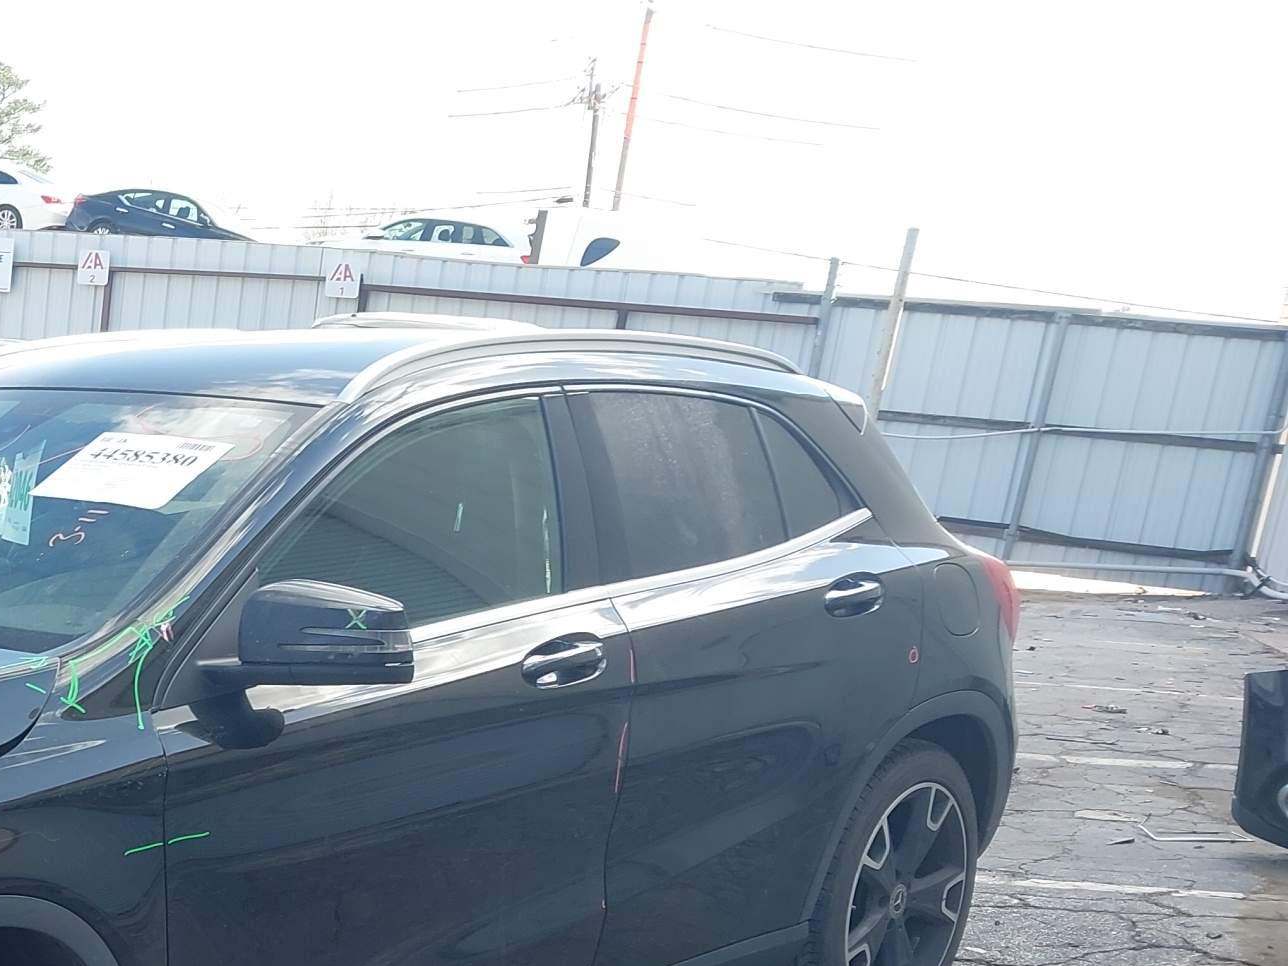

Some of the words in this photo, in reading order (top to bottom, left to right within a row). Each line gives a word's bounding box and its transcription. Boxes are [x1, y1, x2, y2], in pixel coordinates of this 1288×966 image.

[89, 274, 96, 283] 2
[338, 287, 344, 295] 1
[89, 447, 198, 467] 44585380
